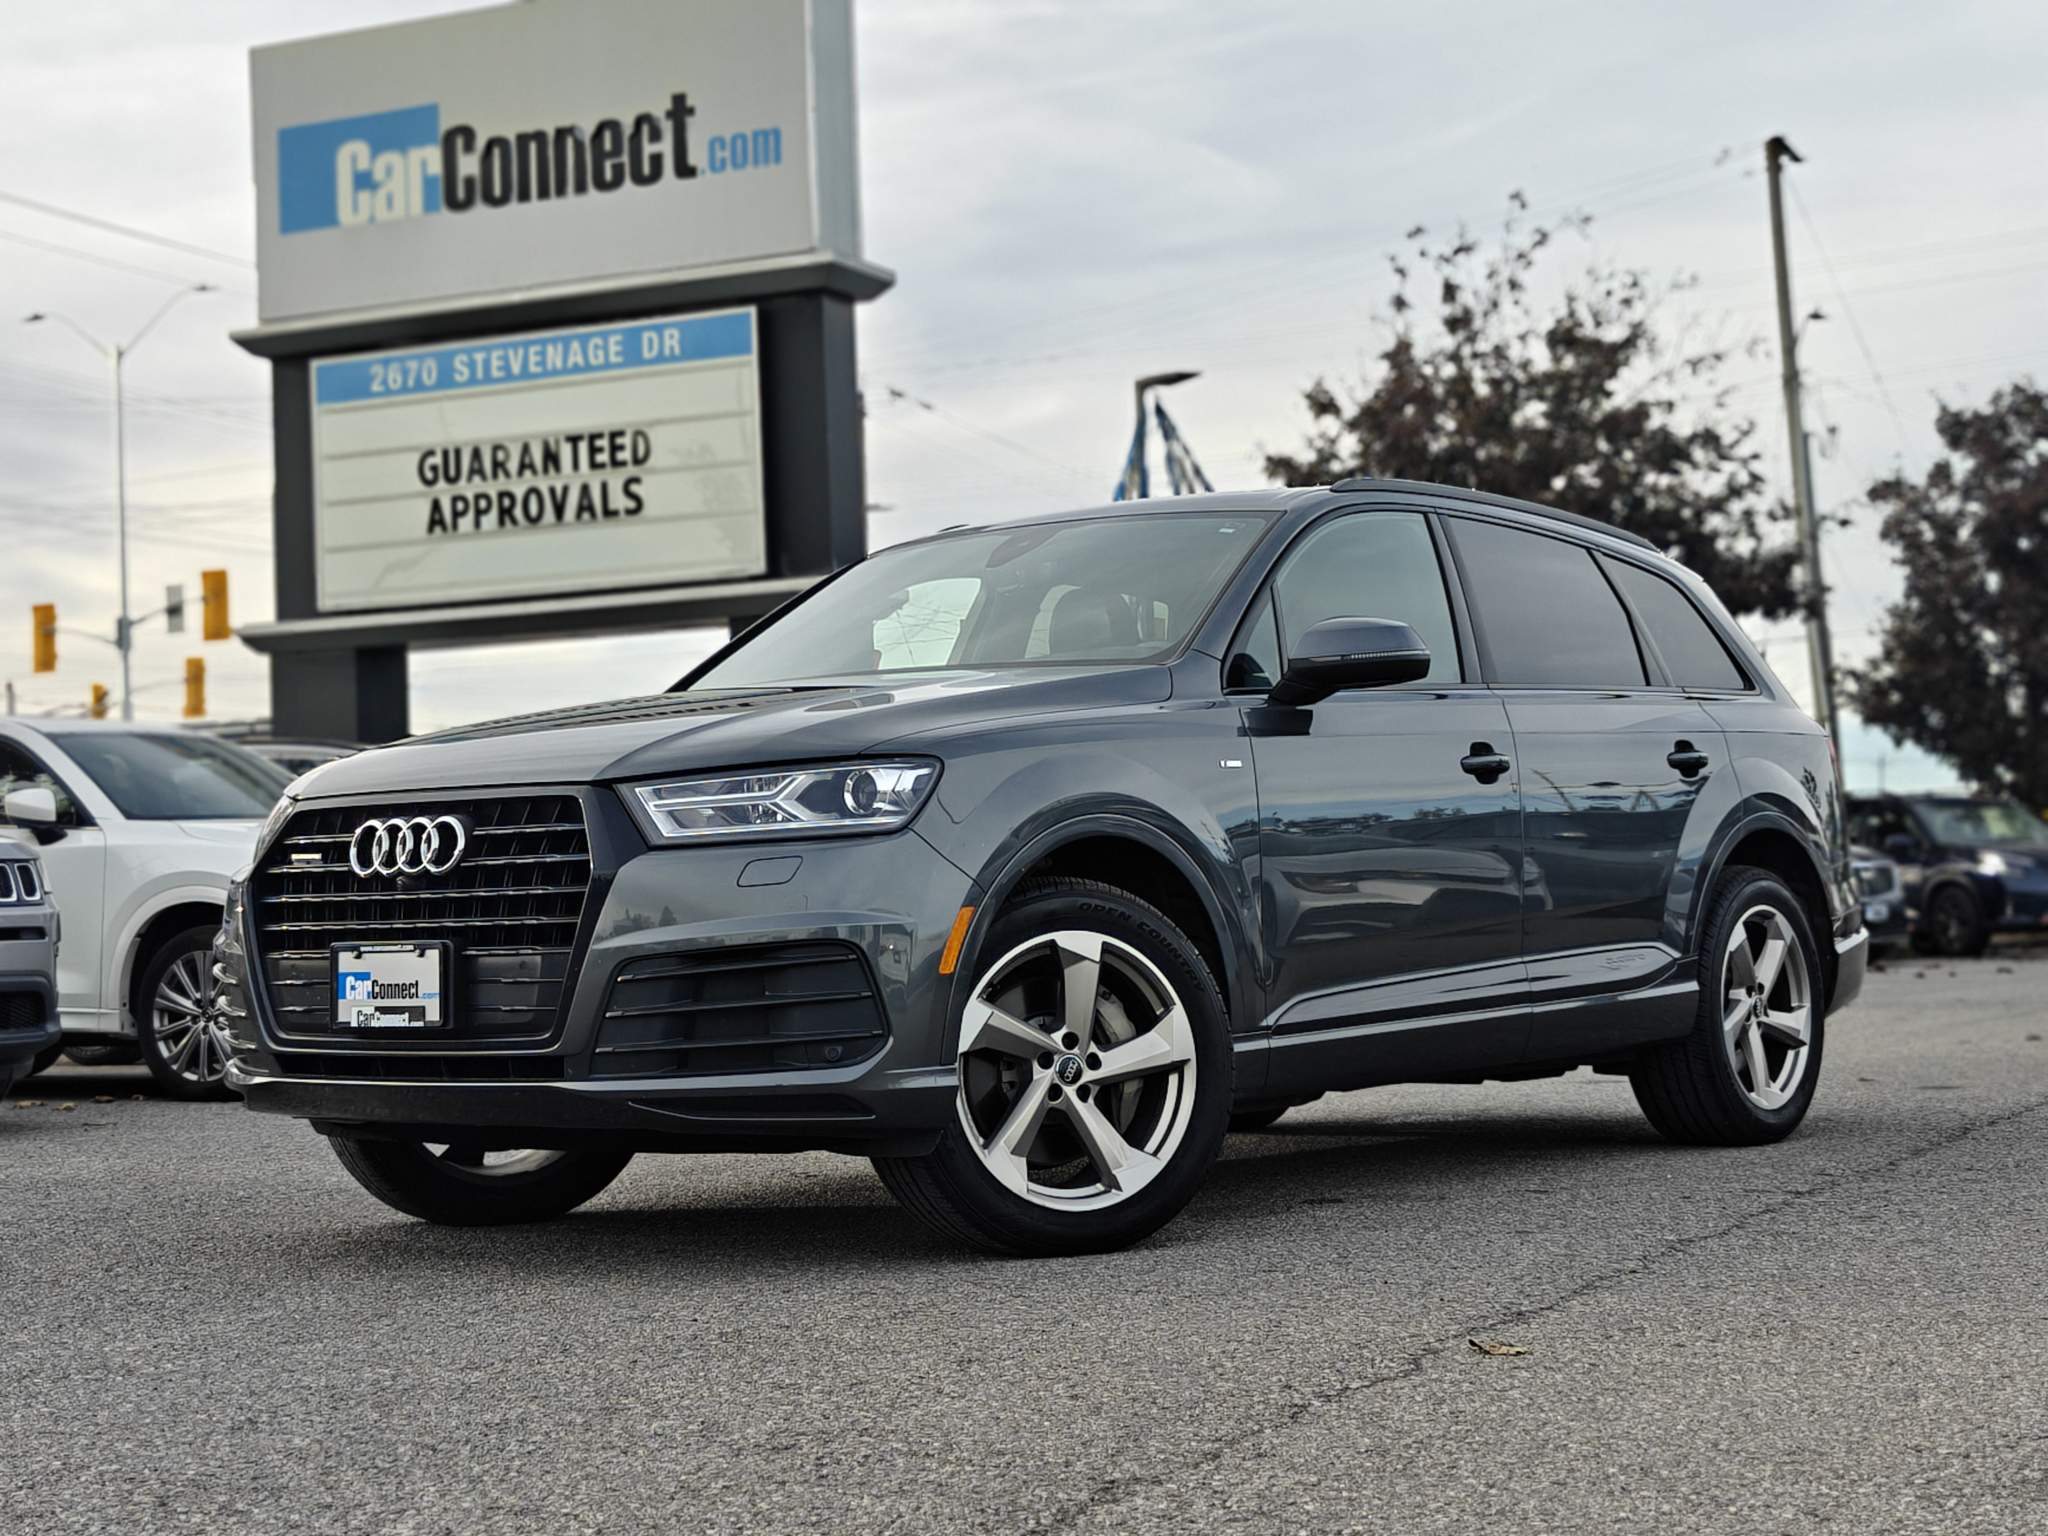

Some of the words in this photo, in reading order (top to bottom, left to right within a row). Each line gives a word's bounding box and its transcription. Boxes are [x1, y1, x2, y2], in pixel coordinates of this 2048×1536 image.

[335, 92, 782, 228] CarConnect.com
[370, 358, 439, 393] 2670
[453, 335, 624, 383] STEVENAGE
[642, 329, 682, 358] DR
[417, 429, 652, 488] GUARANTEED
[426, 476, 644, 536] APPROVALS
